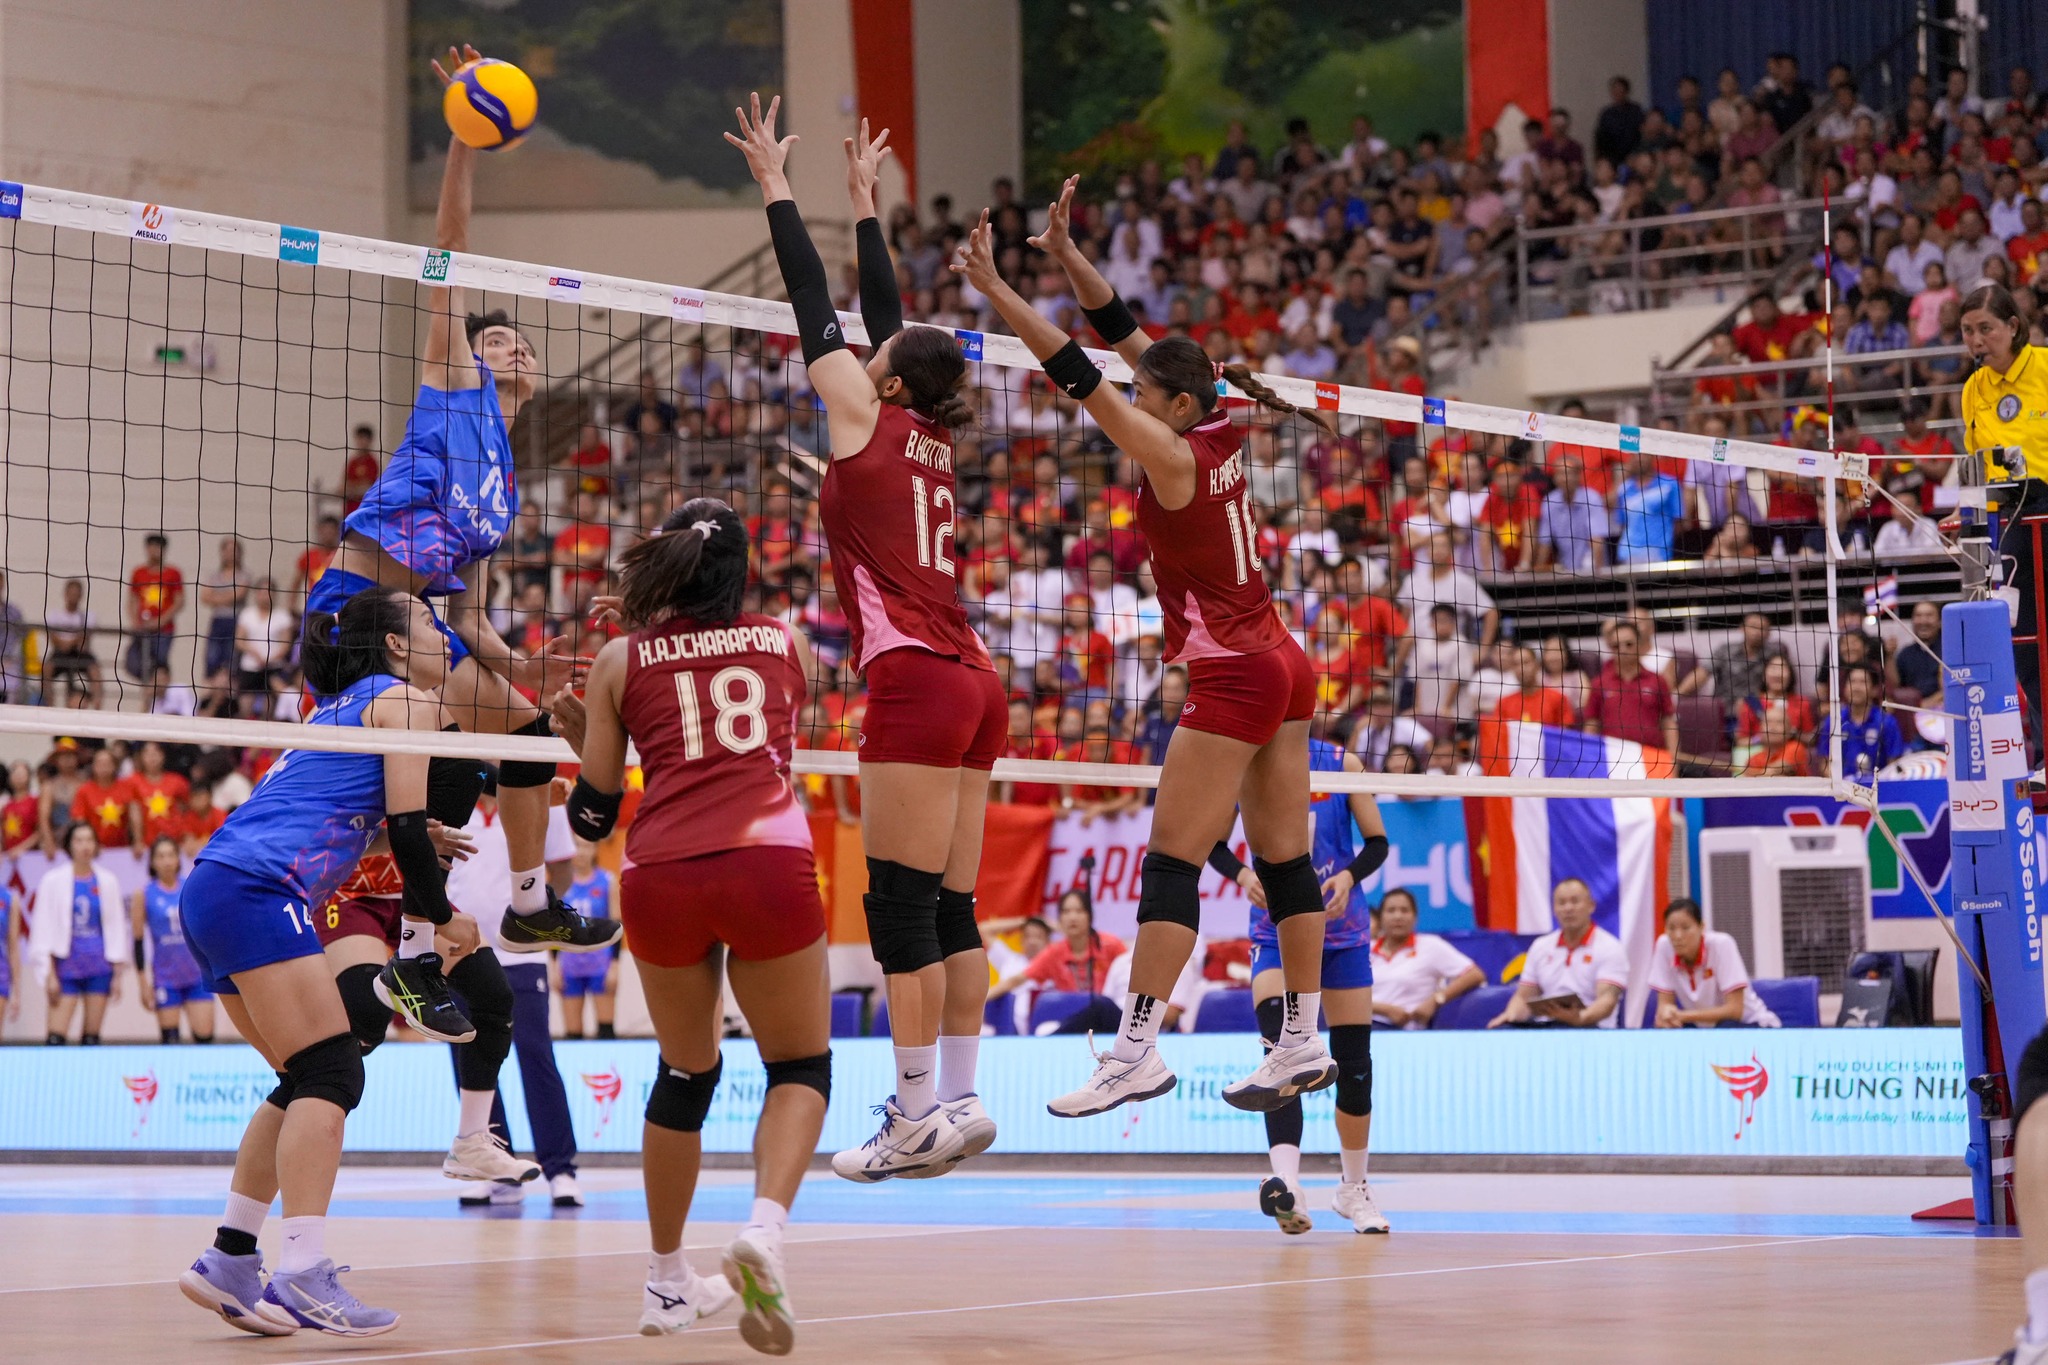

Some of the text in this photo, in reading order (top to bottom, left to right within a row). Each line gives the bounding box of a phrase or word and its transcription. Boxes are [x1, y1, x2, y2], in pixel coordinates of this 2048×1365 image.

[135, 229, 168, 242] MERALCO
[280, 238, 318, 252] PHUMY
[424, 266, 446, 277] CAKE
[426, 256, 449, 267] EURO
[451, 483, 502, 545] PHUM
[912, 475, 955, 578] 12
[674, 665, 768, 761] 18
[1968, 705, 1985, 774] Senoh
[1952, 799, 1998, 812] BYD
[1969, 900, 2002, 910] Senoh
[2019, 841, 2041, 962] Senoh
[283, 902, 317, 935] 14
[326, 904, 339, 929] 6
[1791, 1075, 1902, 1099] THUNG
